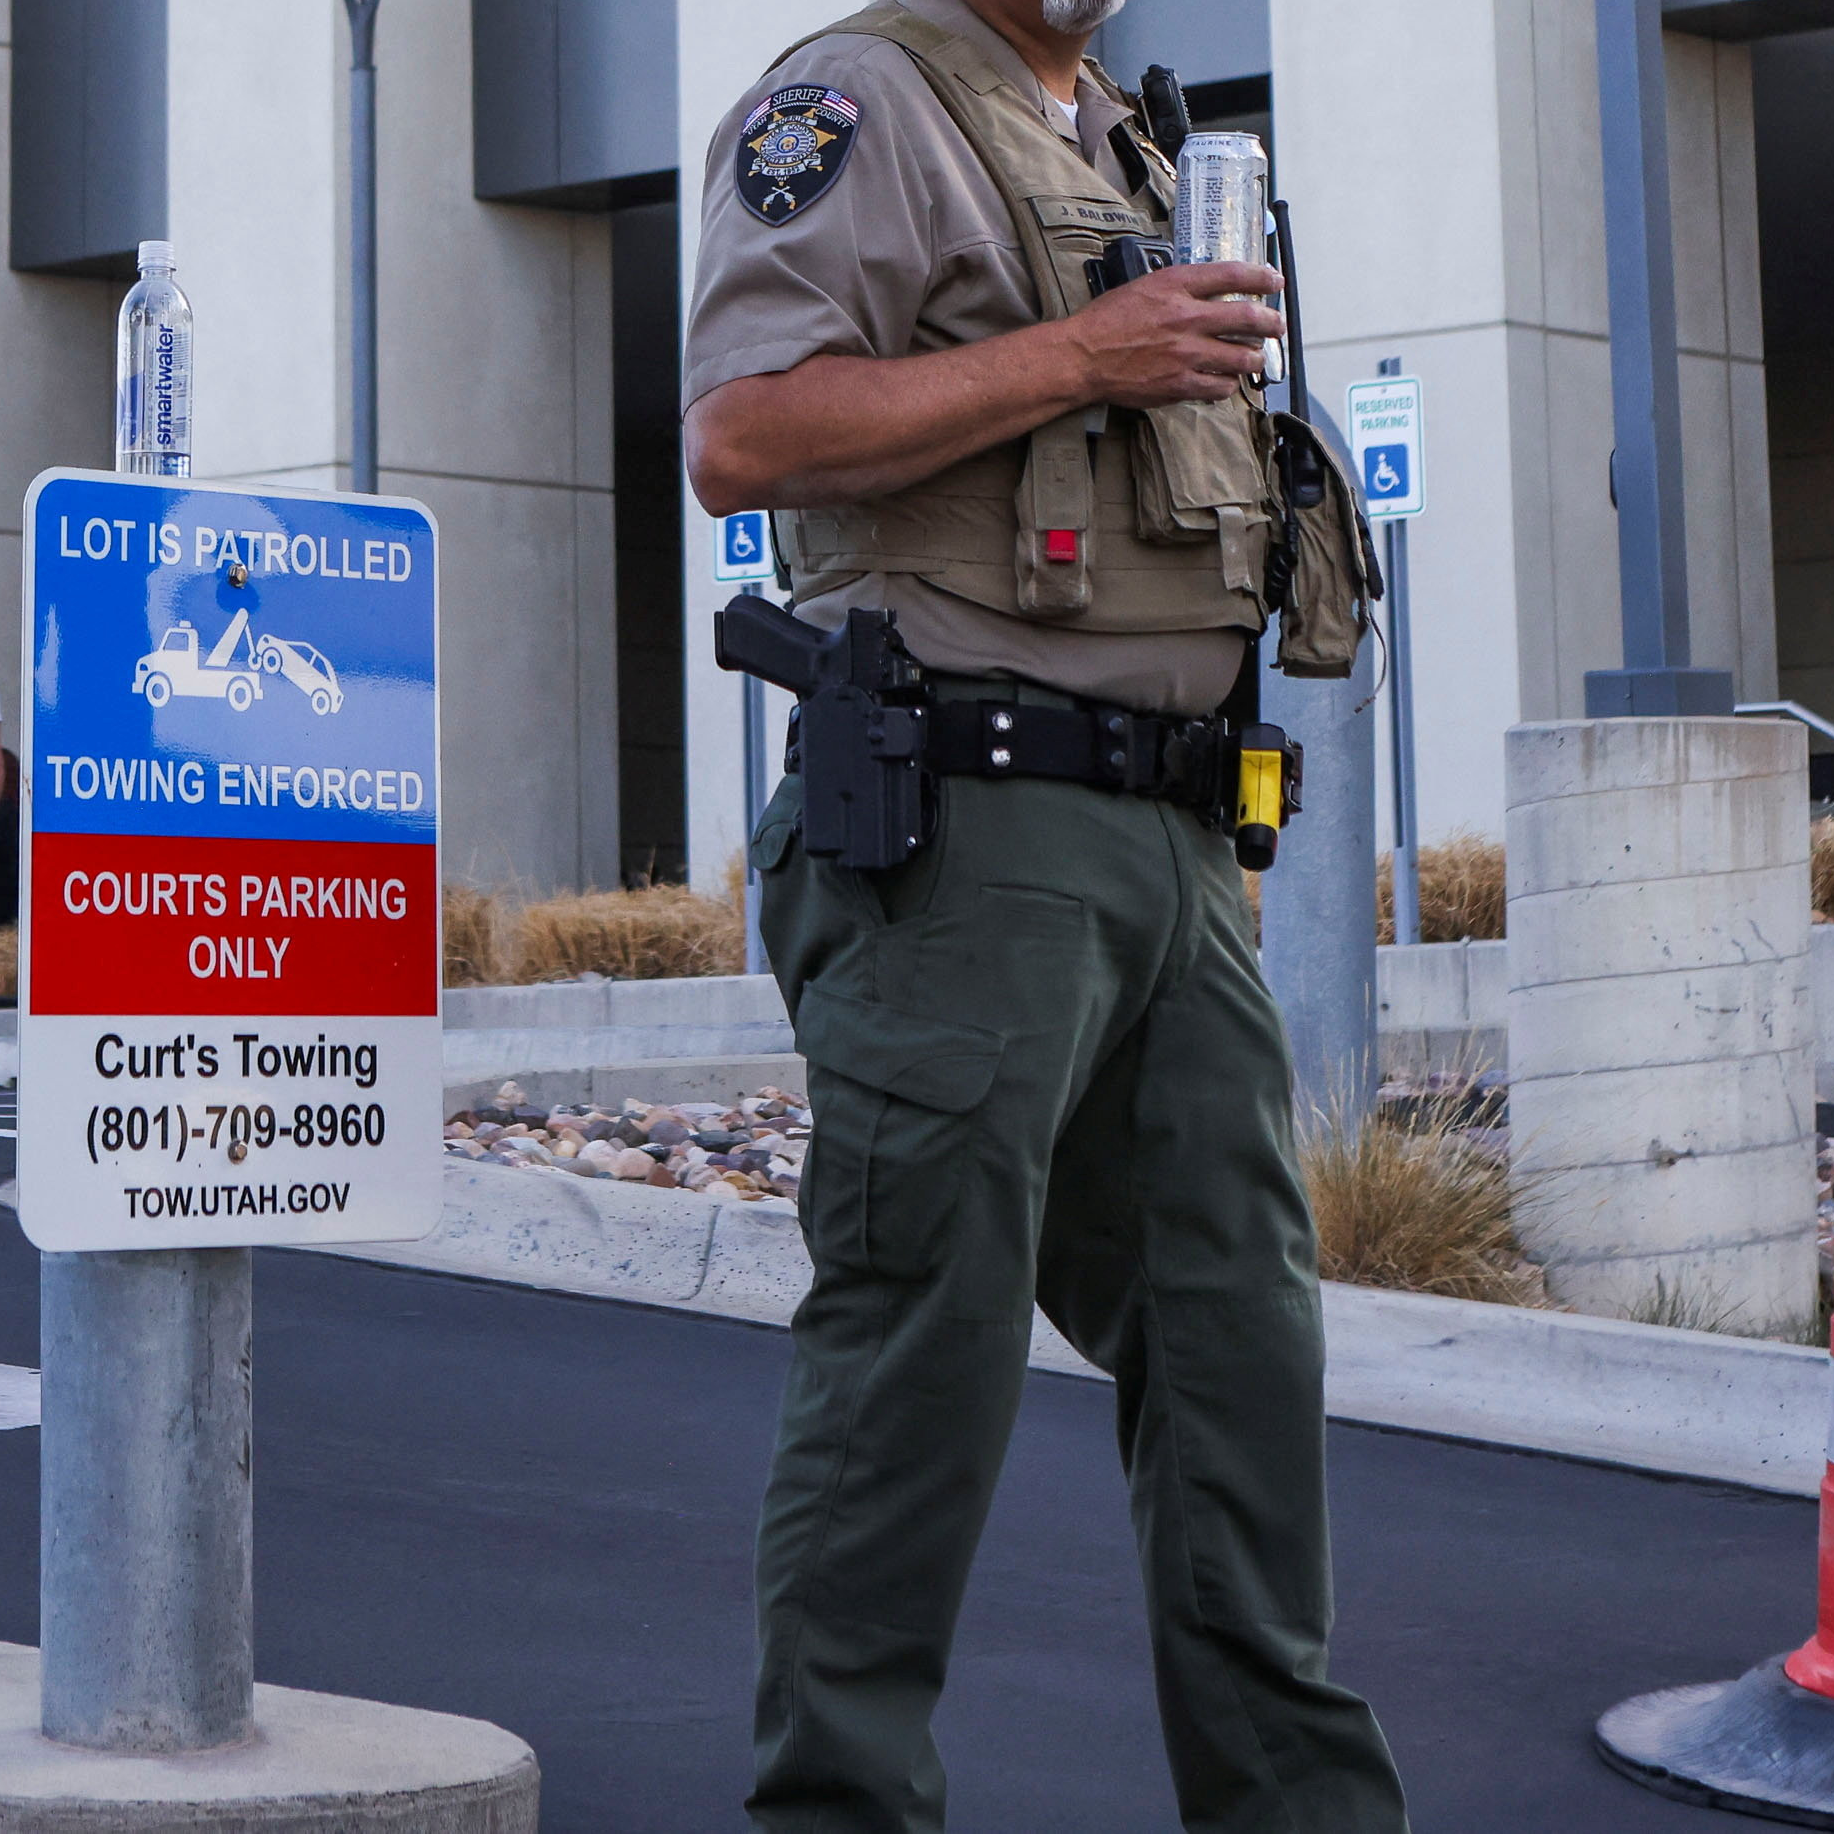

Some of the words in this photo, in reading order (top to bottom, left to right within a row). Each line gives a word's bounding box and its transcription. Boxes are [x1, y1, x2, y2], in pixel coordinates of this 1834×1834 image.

[772, 88, 825, 106] SHERIFF
[747, 115, 768, 135] UTAH
[815, 107, 850, 128] COUNTY
[1059, 205, 1074, 217] J.
[1077, 207, 1140, 226] BALDWIN
[156, 323, 175, 445] smartwater
[1355, 396, 1414, 414] RESERVED
[1360, 413, 1409, 430] PARKING
[61, 516, 136, 561] LOT
[149, 522, 182, 566] IS
[195, 526, 412, 582] PATROLLED
[47, 756, 205, 804] TOWING
[219, 762, 423, 812] ENFORCED
[64, 871, 227, 916] COURTS
[241, 875, 407, 920] PARKING
[188, 935, 290, 978] ONLY
[95, 1033, 219, 1079] Curt's
[232, 1033, 378, 1089] Towing
[86, 1103, 385, 1164] (801)-709-8960
[123, 1182, 351, 1219] TOW.UTAH.GOV
